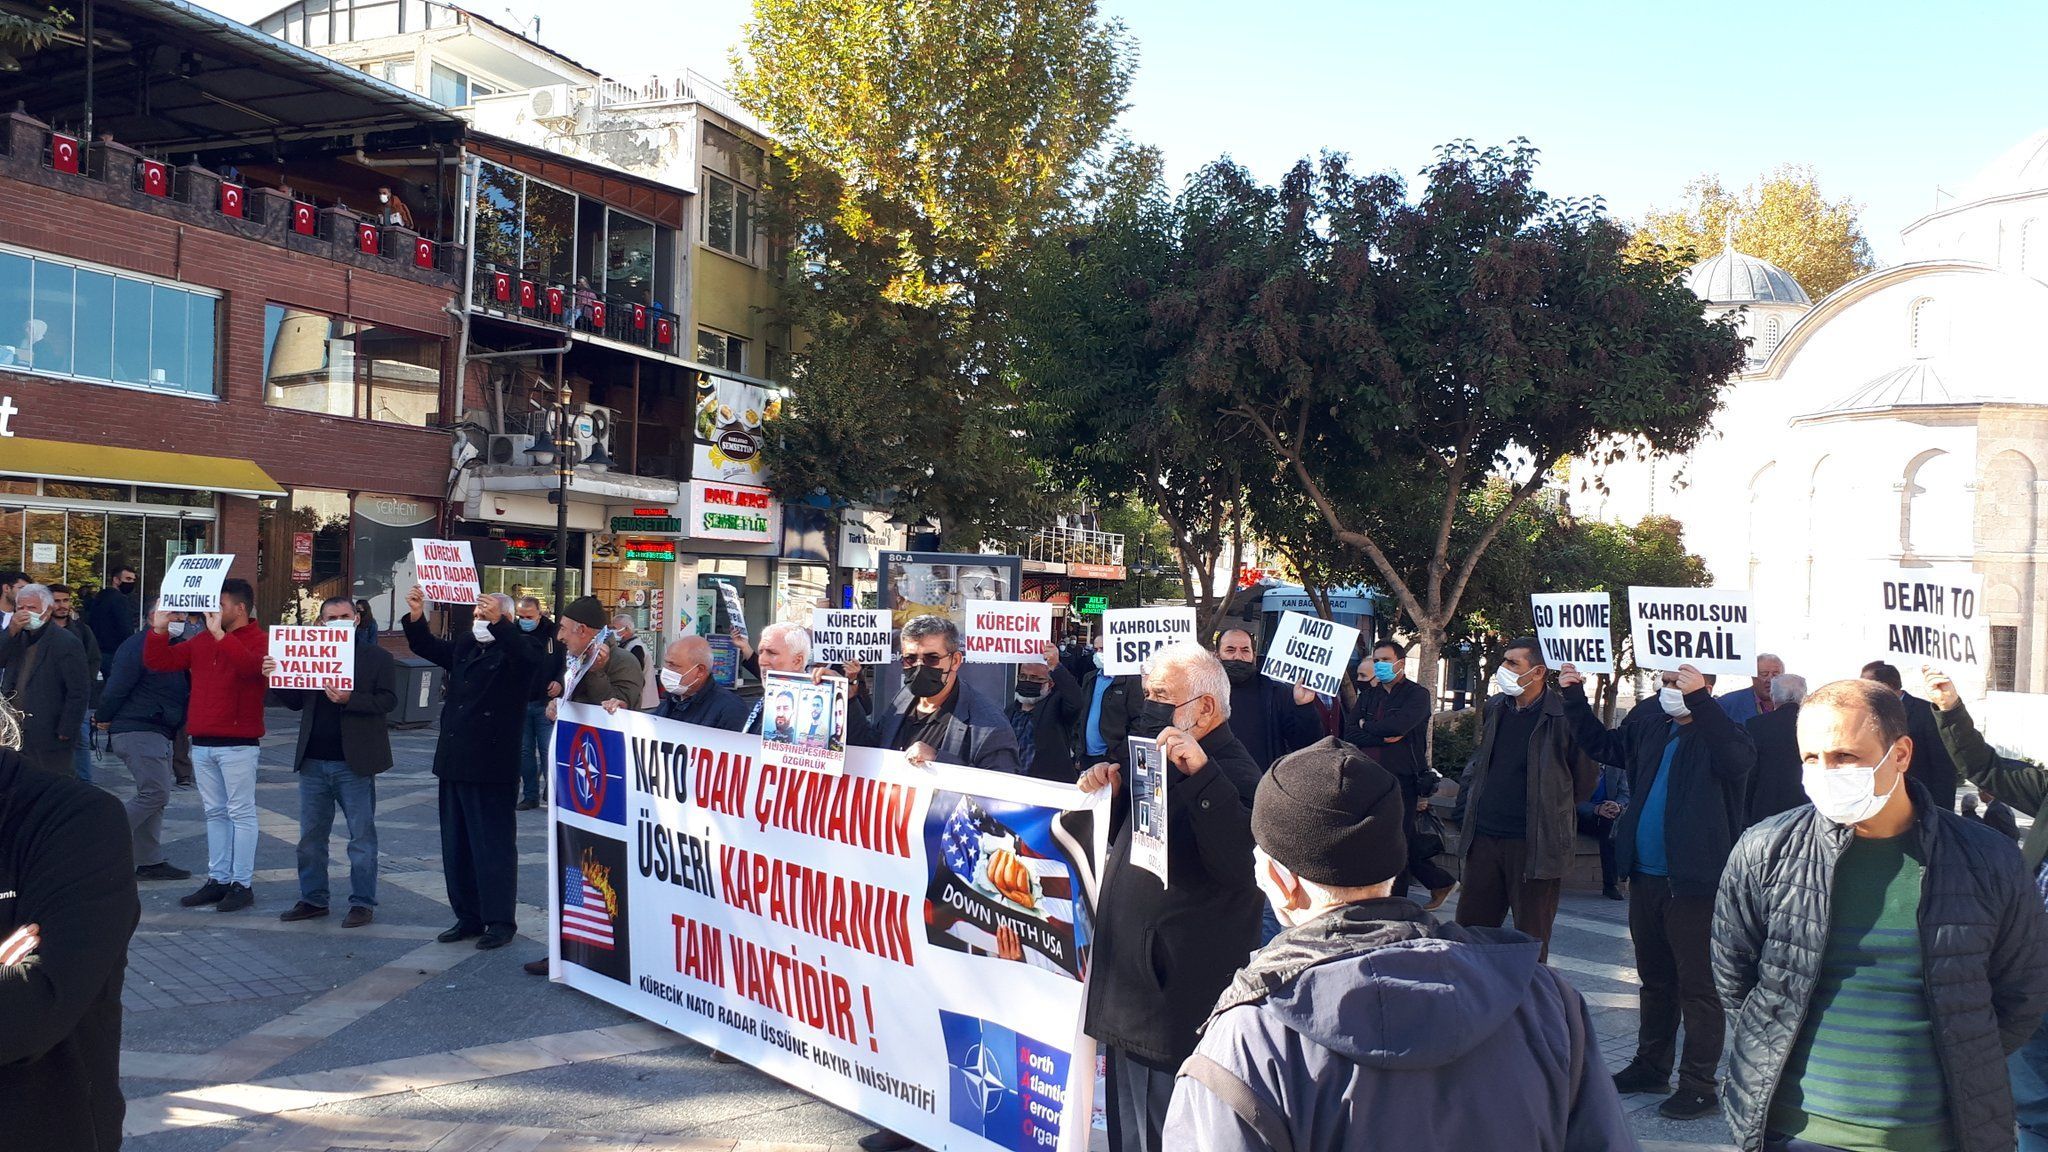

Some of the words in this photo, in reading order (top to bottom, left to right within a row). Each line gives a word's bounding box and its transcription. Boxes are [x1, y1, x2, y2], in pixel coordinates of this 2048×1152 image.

[610, 515, 682, 534] ŞEMSETTİN
[424, 542, 462, 562] KÜRECİK
[889, 554, 914, 562] 80-A
[178, 558, 224, 570] FREEDOM
[417, 564, 442, 580] NATO
[443, 566, 478, 582] RADARI
[183, 576, 202, 588] FOR
[426, 582, 475, 602] SÖKÜLSÜN
[163, 592, 210, 608] PALESTİNE
[1282, 600, 1296, 608] KAN
[1330, 600, 1348, 608] RACI
[1883, 582, 1944, 616] DEATH
[1951, 587, 1974, 620] TO
[827, 612, 877, 628] KÜRECİK
[976, 611, 1040, 632] KÜRECİK
[1534, 604, 1554, 628] GO
[1559, 604, 1609, 628] HOME
[1638, 602, 1748, 624] KAHROLSUN
[275, 627, 348, 642] FİLİSTİN
[1110, 620, 1190, 634] KAHROLSUN
[1298, 618, 1334, 640] NATO
[814, 631, 842, 644] NATO
[847, 632, 890, 646] RADARI
[966, 636, 1050, 654] KAPATILSIN
[1647, 624, 1742, 660] İSRAİL
[1889, 624, 1978, 665] AMERİCA
[285, 645, 337, 658] HALKI
[1285, 636, 1334, 666] ÜSLERİ
[1544, 638, 1606, 662] YANKEE
[280, 660, 342, 674] YALNIZ
[1262, 657, 1342, 695] KAPATILSIN
[271, 674, 352, 688] DEĞİLDİR
[632, 736, 752, 818] NATO'DAN
[755, 764, 916, 859] ÇIKMANIN
[638, 808, 716, 899] ÜSLERİ
[720, 844, 914, 967] KAPATMANIN
[942, 883, 991, 925] DOWN
[995, 912, 1038, 942] WITH
[1042, 930, 1063, 960] USA
[672, 913, 725, 989] TAM
[728, 944, 858, 1046] VAKTİDİR
[862, 984, 879, 1053] !
[639, 974, 684, 1008] KÜRECİK
[686, 993, 714, 1019] NATO
[718, 1005, 757, 1036] RADAR
[760, 1019, 810, 1060] ÜSSÜNE
[812, 1046, 852, 1078] HAYIR
[855, 1060, 936, 1115] İNİSİYATİFİ
[1020, 1046, 1054, 1076] North
[1021, 1070, 1066, 1102] Atlantic
[1023, 1118, 1060, 1148] Organ
